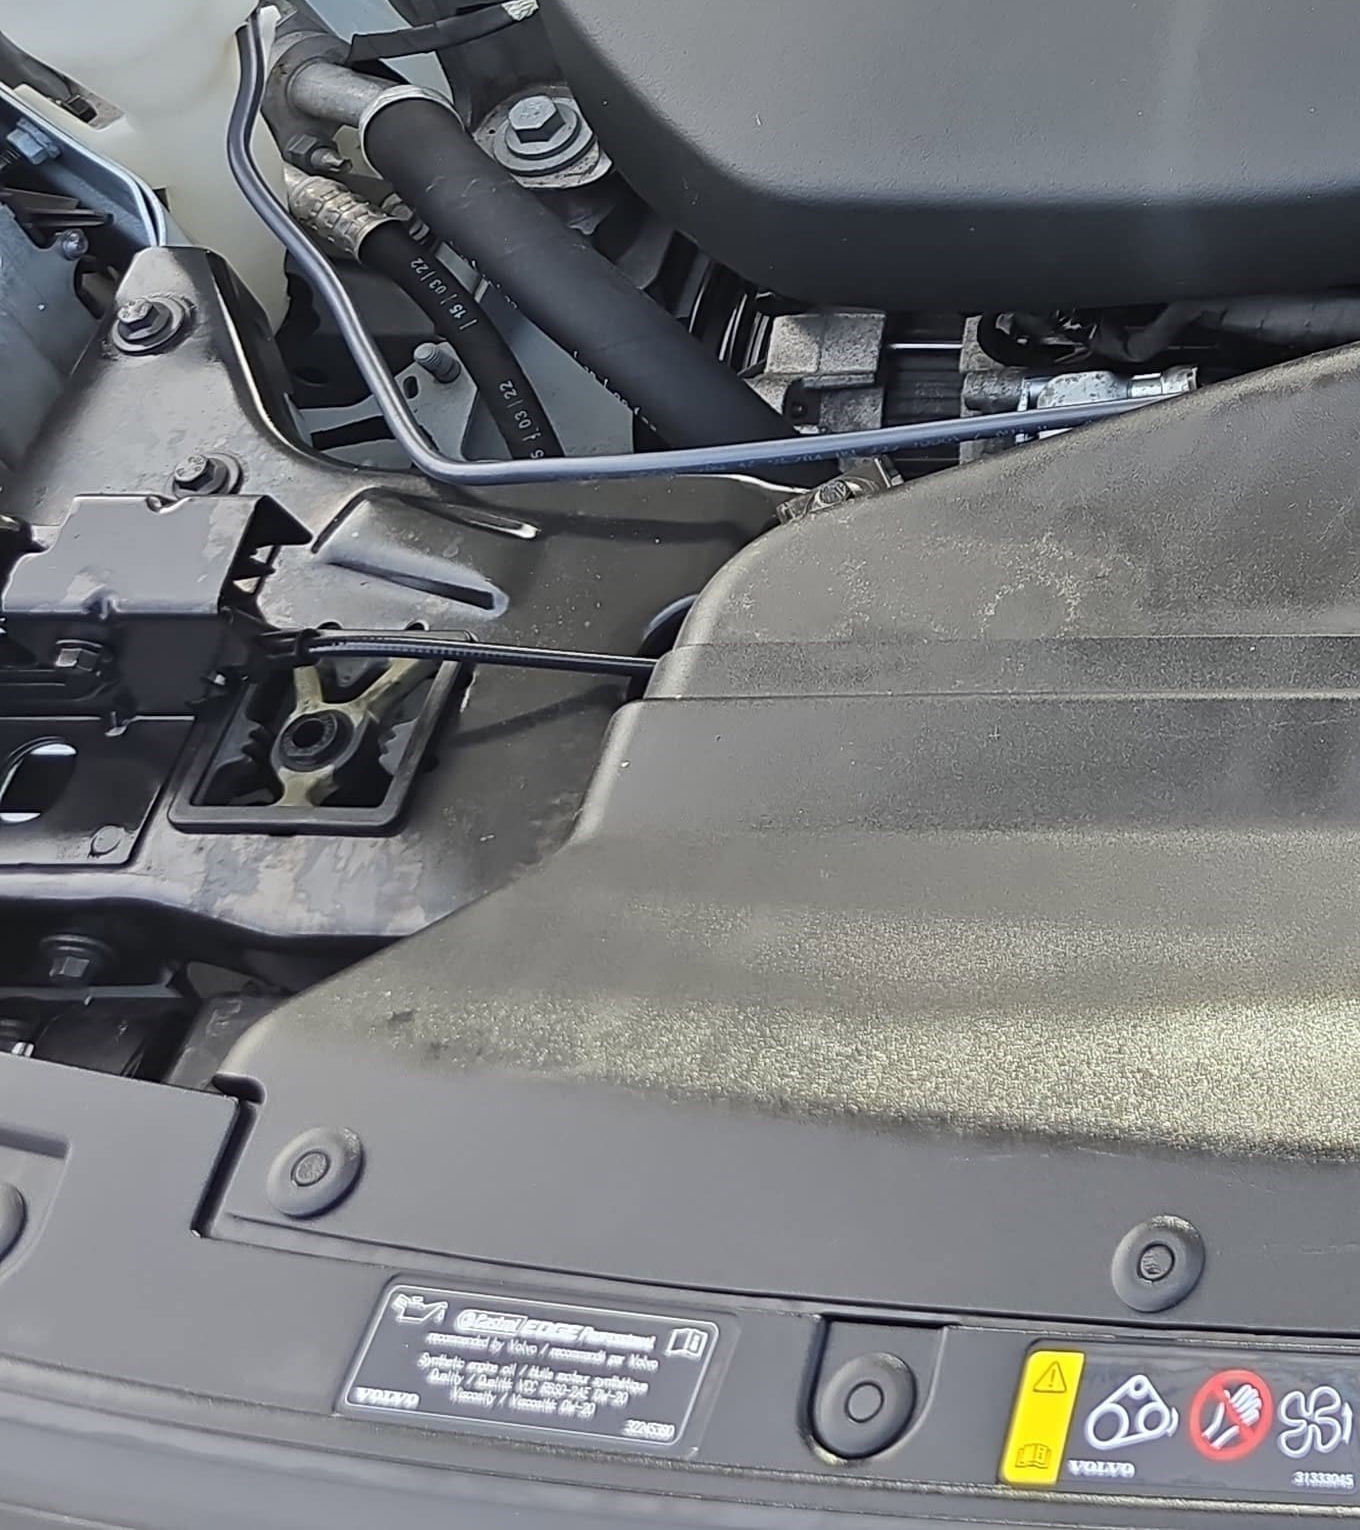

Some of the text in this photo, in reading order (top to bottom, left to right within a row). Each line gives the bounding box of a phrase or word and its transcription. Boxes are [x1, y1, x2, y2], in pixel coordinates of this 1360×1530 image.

[410, 257, 429, 275] 22
[499, 380, 518, 401] 22
[514, 410, 532, 430] 03
[507, 1338, 538, 1355] Volvo
[628, 1353, 659, 1371] Volvo
[1067, 1459, 1136, 1478] VOLVO
